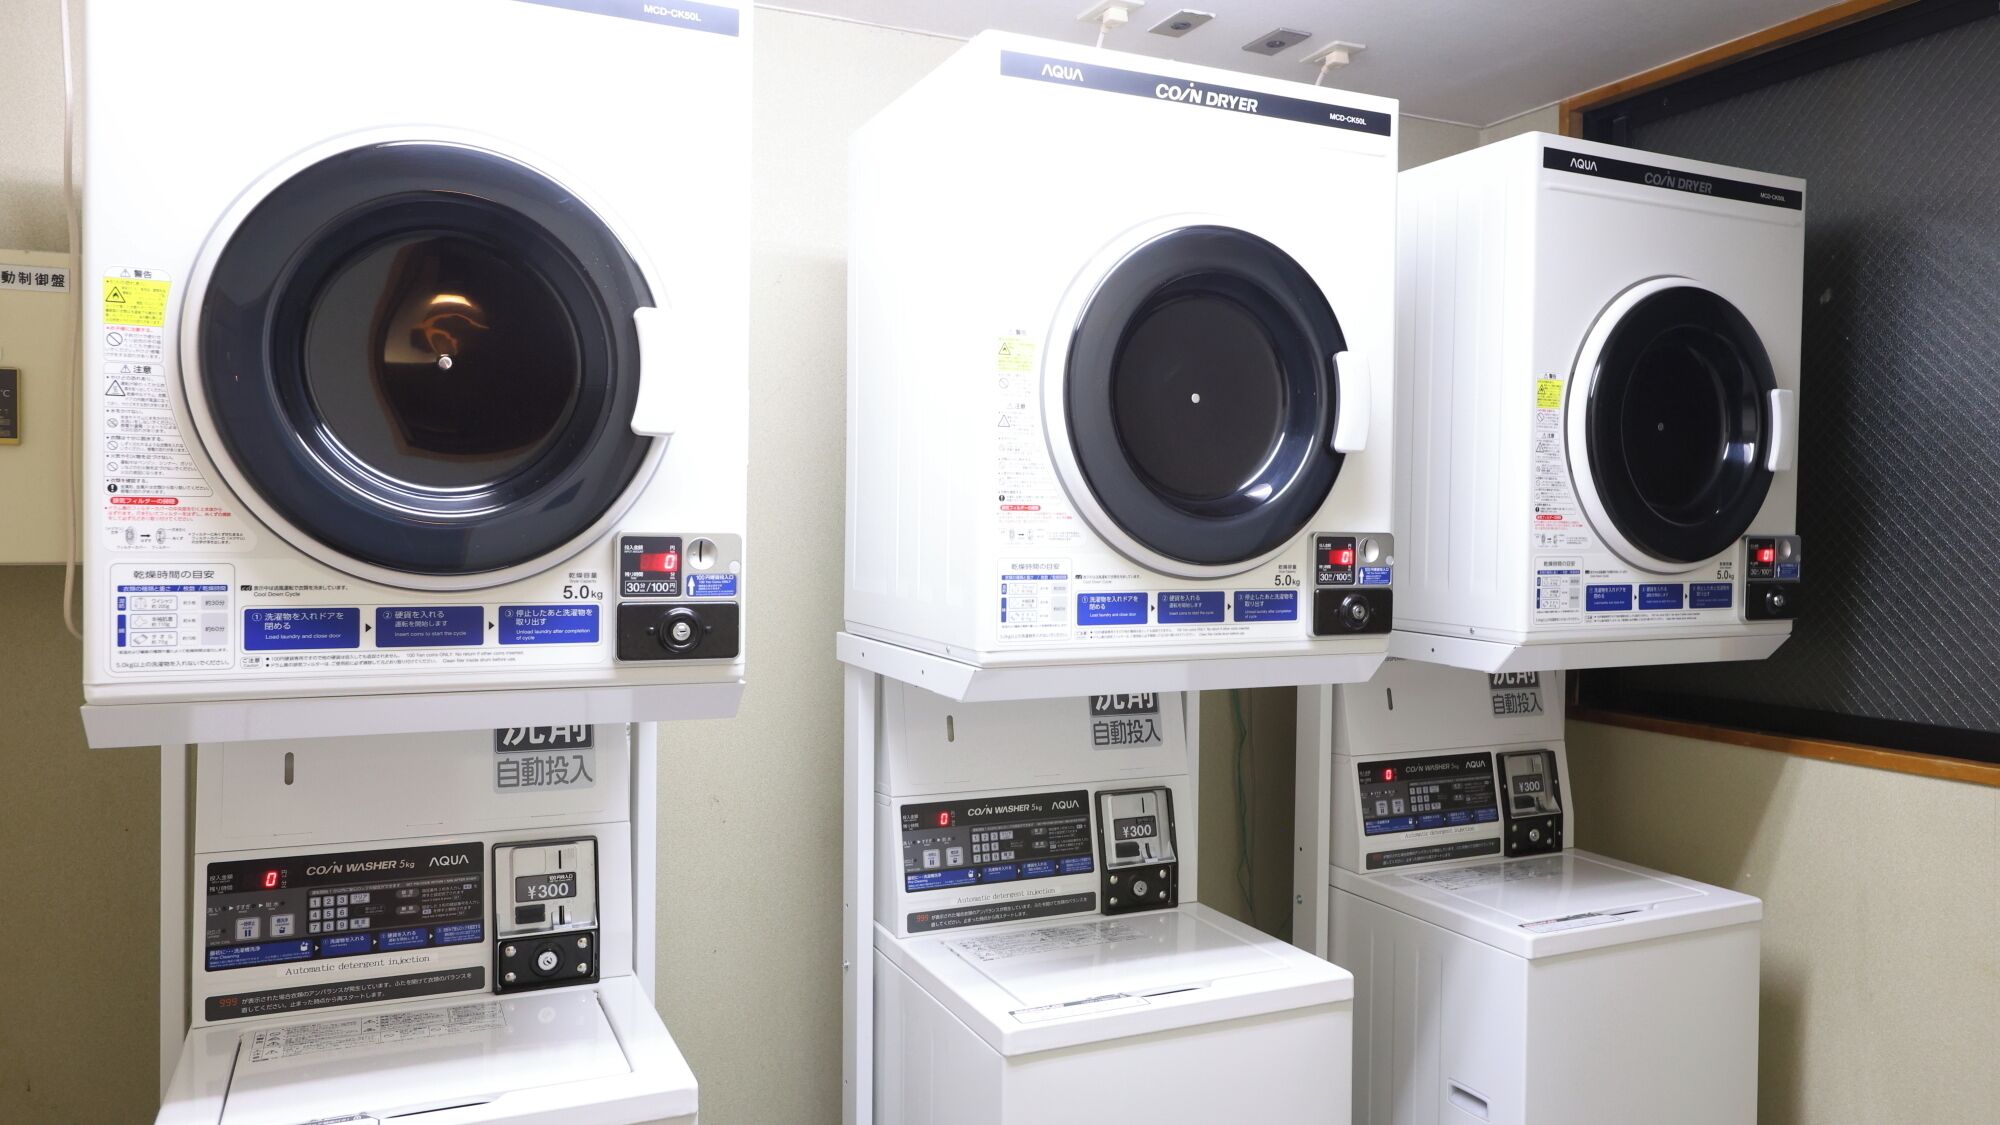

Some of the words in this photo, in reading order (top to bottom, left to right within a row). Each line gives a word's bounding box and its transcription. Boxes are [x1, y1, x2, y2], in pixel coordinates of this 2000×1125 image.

[643, 4, 702, 22] MCD-CK50L
[1041, 63, 1084, 82] AQUA
[1205, 91, 1259, 113] DRYER
[1329, 112, 1367, 126] MCD-CK50L
[1569, 157, 1598, 172] AQUA
[1677, 177, 1713, 195] DRYER
[664, 554, 676, 570] 0
[1341, 551, 1350, 563] 0
[133, 570, 215, 580] 乾燥時間の目安
[264, 612, 344, 621] 洗濯物を入れドアを
[394, 610, 445, 619] 硬貨を入れる
[516, 609, 593, 618] 停止したあと洗濯物を
[264, 622, 291, 631] 閉める
[515, 618, 547, 626] 取り出す
[1492, 692, 1543, 715] 自動投入
[1093, 718, 1161, 746] 自動投入
[497, 755, 593, 788] 自動投入
[1465, 760, 1486, 769] AQUA
[1385, 769, 1392, 780] 0
[995, 803, 1030, 815] WASHER
[1051, 799, 1080, 810] AQUA
[939, 812, 948, 825] 0
[1122, 824, 1152, 838] ¥300
[346, 860, 396, 873] WASHER
[399, 859, 415, 869] 5kg
[429, 854, 469, 868] AQUA
[265, 871, 277, 887] 0
[527, 882, 569, 900] ¥300
[956, 894, 990, 904] Automatic
[992, 890, 1024, 901] detergent
[285, 965, 336, 976] Automatic
[338, 959, 385, 971] detergent
[387, 955, 430, 966] injection
